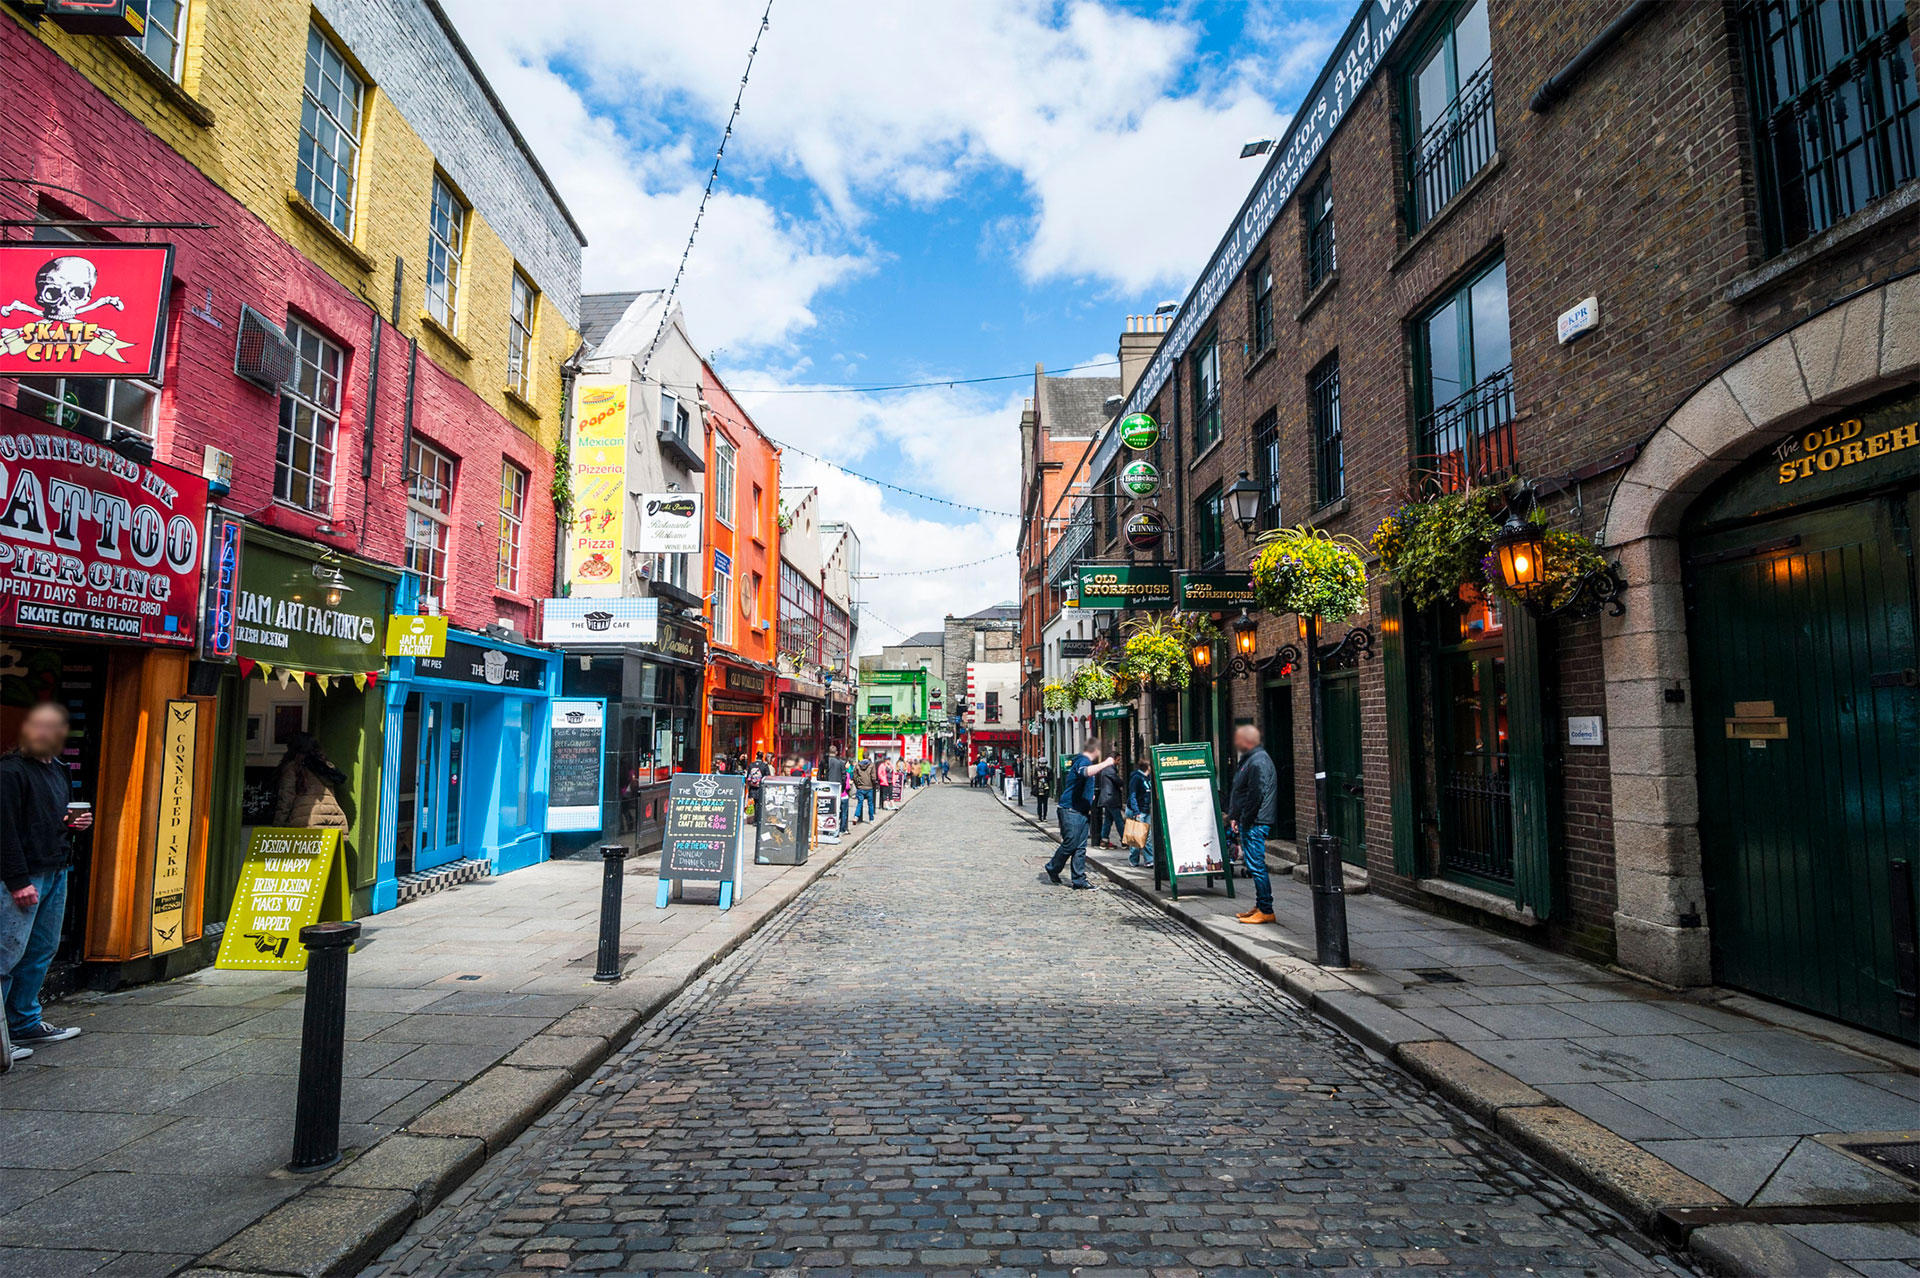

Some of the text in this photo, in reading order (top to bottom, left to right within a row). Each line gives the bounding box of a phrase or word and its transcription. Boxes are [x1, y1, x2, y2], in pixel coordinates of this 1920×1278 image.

[1162, 296, 1197, 367] Household
[1199, 226, 1241, 306] Removal
[1243, 95, 1327, 235] Contractors
[1334, 18, 1370, 94] and
[1187, 276, 1226, 342] throughout
[1228, 251, 1244, 283] the
[1246, 202, 1276, 253] entire
[1279, 130, 1324, 205] system
[1329, 92, 1343, 129] of
[1568, 307, 1588, 326] KPR
[23, 322, 98, 343] SKATE
[26, 342, 89, 362] CITY
[579, 400, 625, 432] Papa's
[578, 437, 624, 447] Mexican
[1772, 418, 1862, 461] The OLD
[595, 451, 606, 462] &
[1779, 421, 1920, 485] STOREH
[0, 434, 140, 483] CONNECTED
[141, 468, 178, 510] INK
[578, 464, 622, 475] Pizzeria
[1125, 475, 1158, 483] Heineken
[603, 480, 623, 502] NACHOS
[0, 461, 198, 575] ATTOO
[1128, 523, 1162, 533] GUINNESS
[578, 538, 615, 549] Pizza
[216, 524, 237, 649] TATTOO
[1081, 573, 1093, 585] The
[1094, 574, 1117, 584] OLD
[1084, 584, 1169, 595] STOREHOUSE
[1186, 591, 1254, 599] STOREHOUSE
[34, 583, 40, 597] 7
[44, 585, 77, 603] DAYS
[86, 591, 104, 608] Tel:
[107, 595, 138, 613] 01-672
[140, 602, 161, 616] 8850
[20, 605, 140, 633] SKATE CITY 1st FLOOR
[238, 591, 360, 641] JAM ART FACTORY
[236, 625, 289, 648] IRISH DESIGN
[399, 634, 433, 646] JAM ART
[399, 644, 432, 656] FACTORY
[422, 658, 442, 670] MY PIES
[471, 663, 485, 677] THE
[505, 668, 520, 682] CAFE
[1570, 730, 1593, 738] Codema
[1161, 759, 1205, 767] STOREHOUSE
[171, 734, 186, 828] CONNECTED
[678, 787, 691, 795] THE
[677, 820, 693, 828] CRAFT
[680, 813, 691, 821] SOFT
[168, 835, 179, 866] INK
[260, 839, 323, 854] DESIGN MAKES
[264, 857, 312, 872] YOU HAPPY
[680, 858, 706, 867] DINNER
[252, 878, 312, 893] IRISH DESIGN
[251, 897, 303, 911] MAKES YOU
[252, 916, 292, 931] HAPPIER
